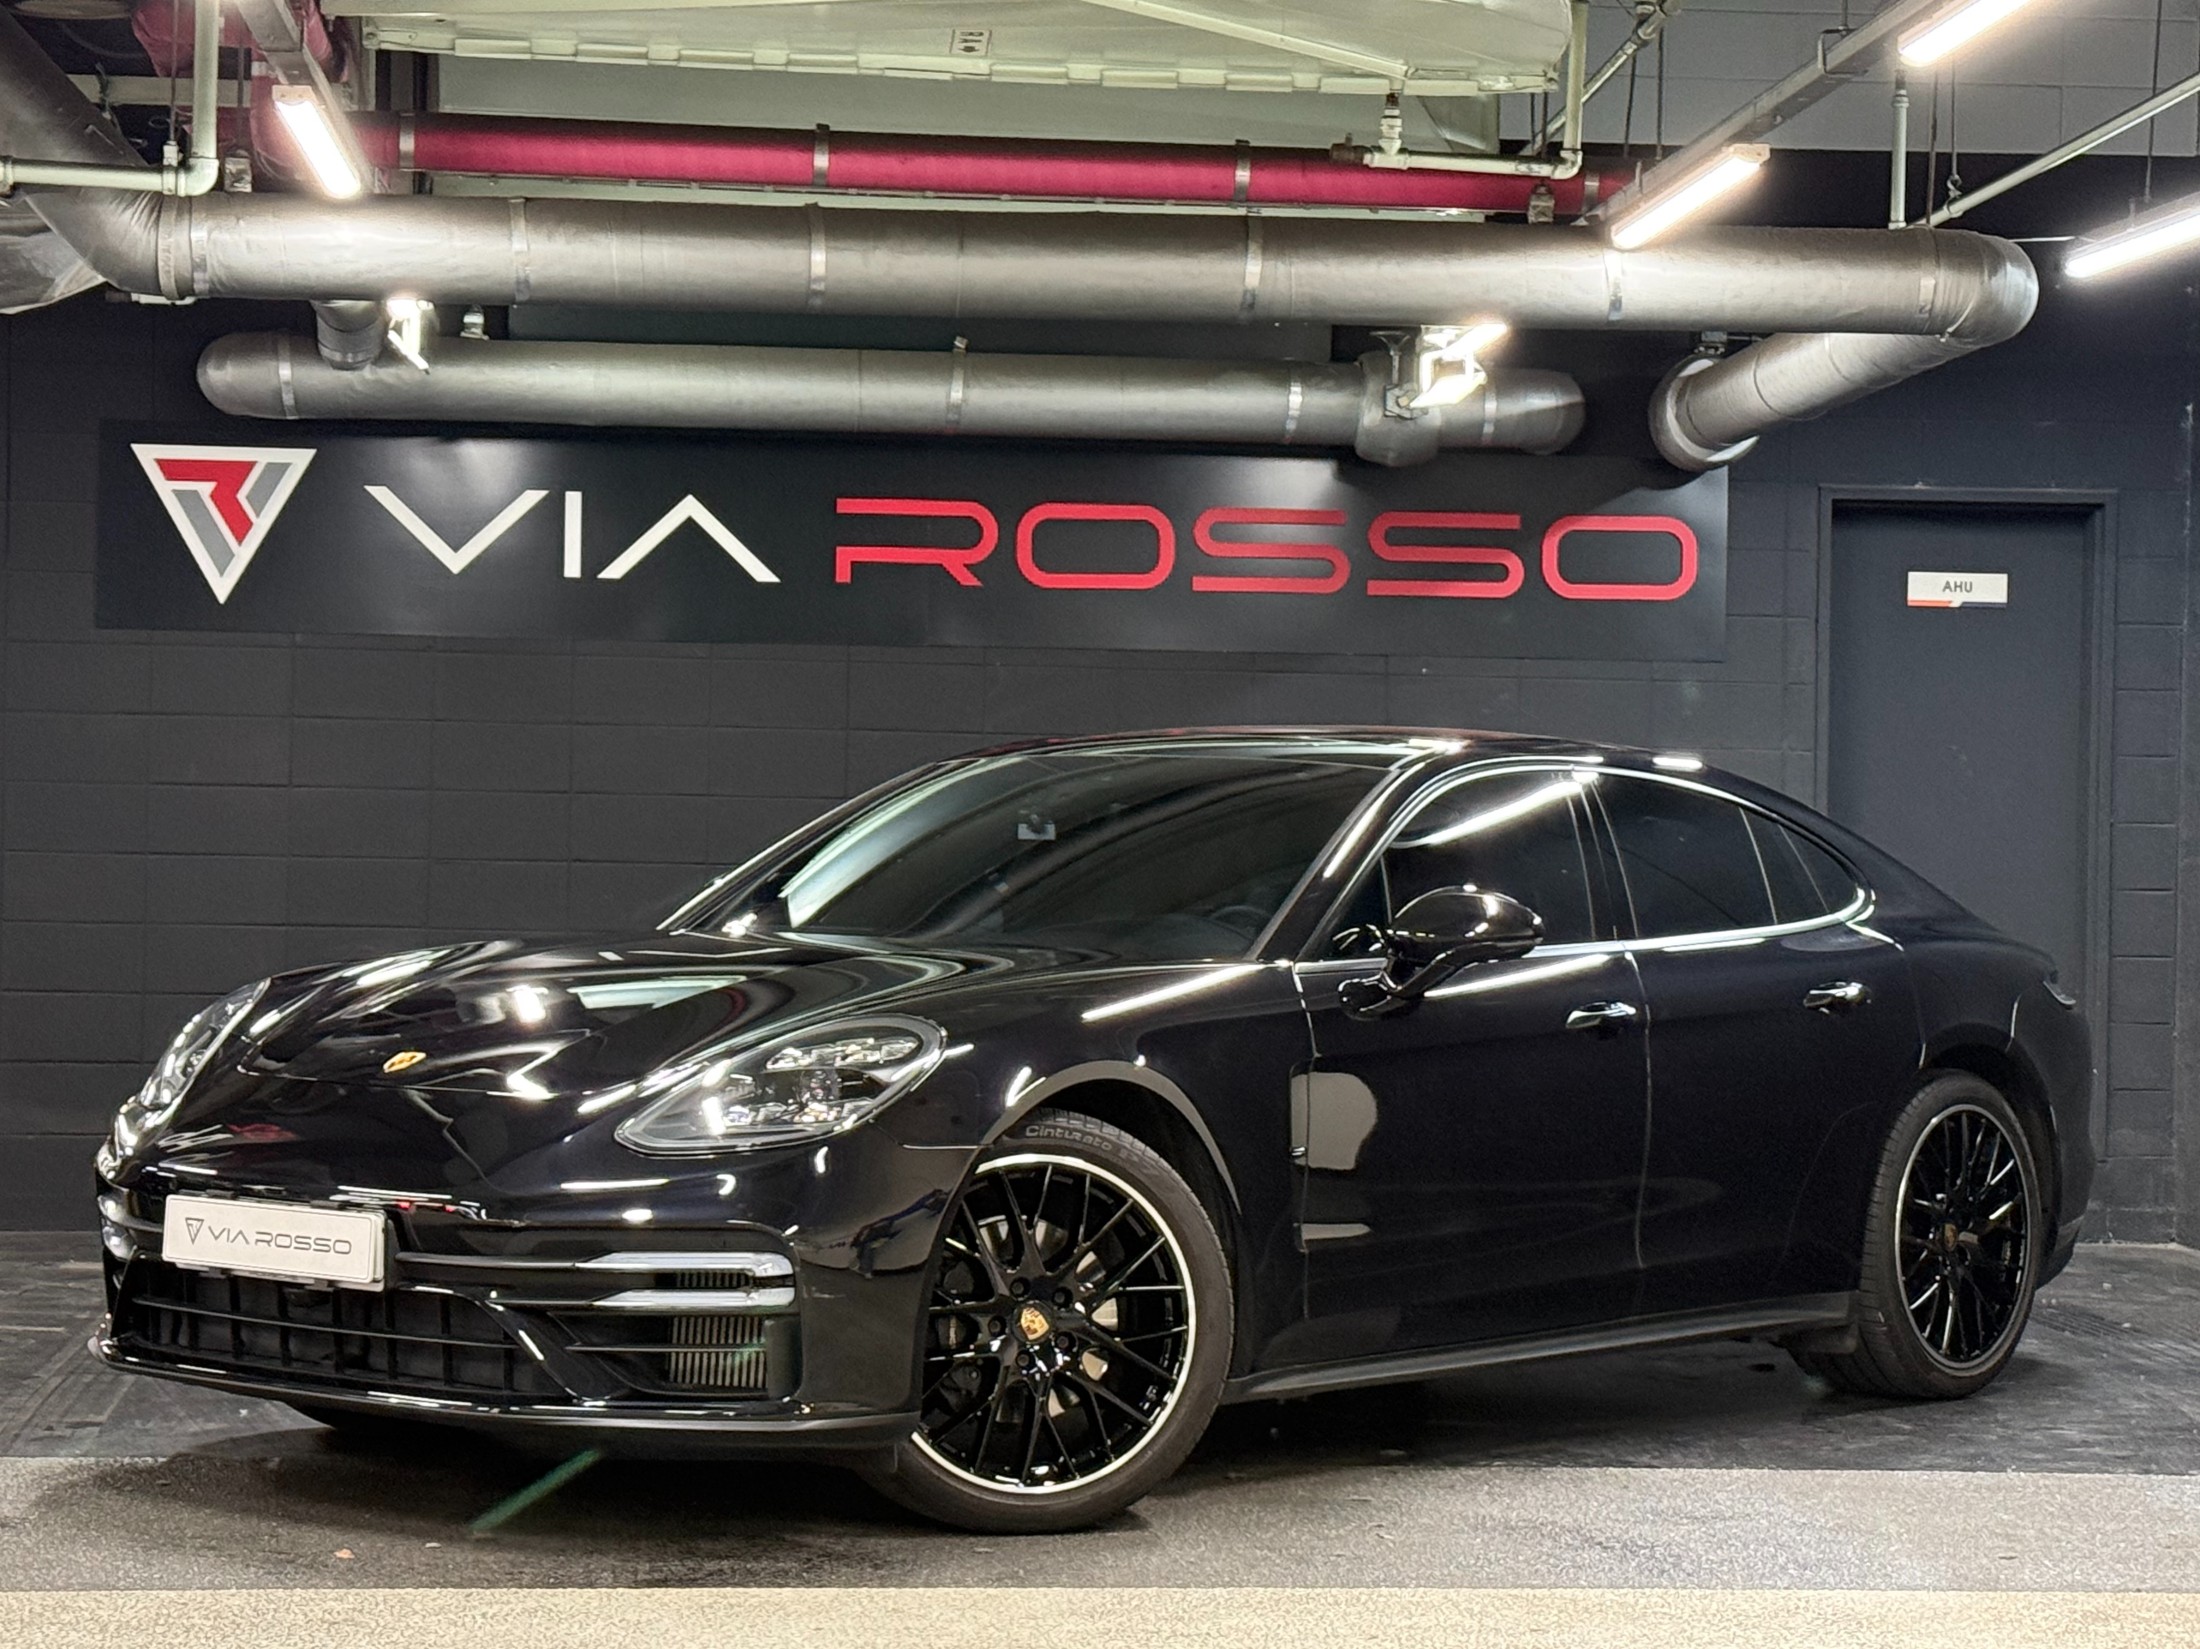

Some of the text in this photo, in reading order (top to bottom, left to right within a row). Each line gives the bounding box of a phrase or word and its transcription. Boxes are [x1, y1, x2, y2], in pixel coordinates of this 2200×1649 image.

[364, 484, 1697, 600] VIA ROSSO
[1942, 580, 1973, 593] AHU
[208, 1225, 352, 1255] VIA ROSSO
